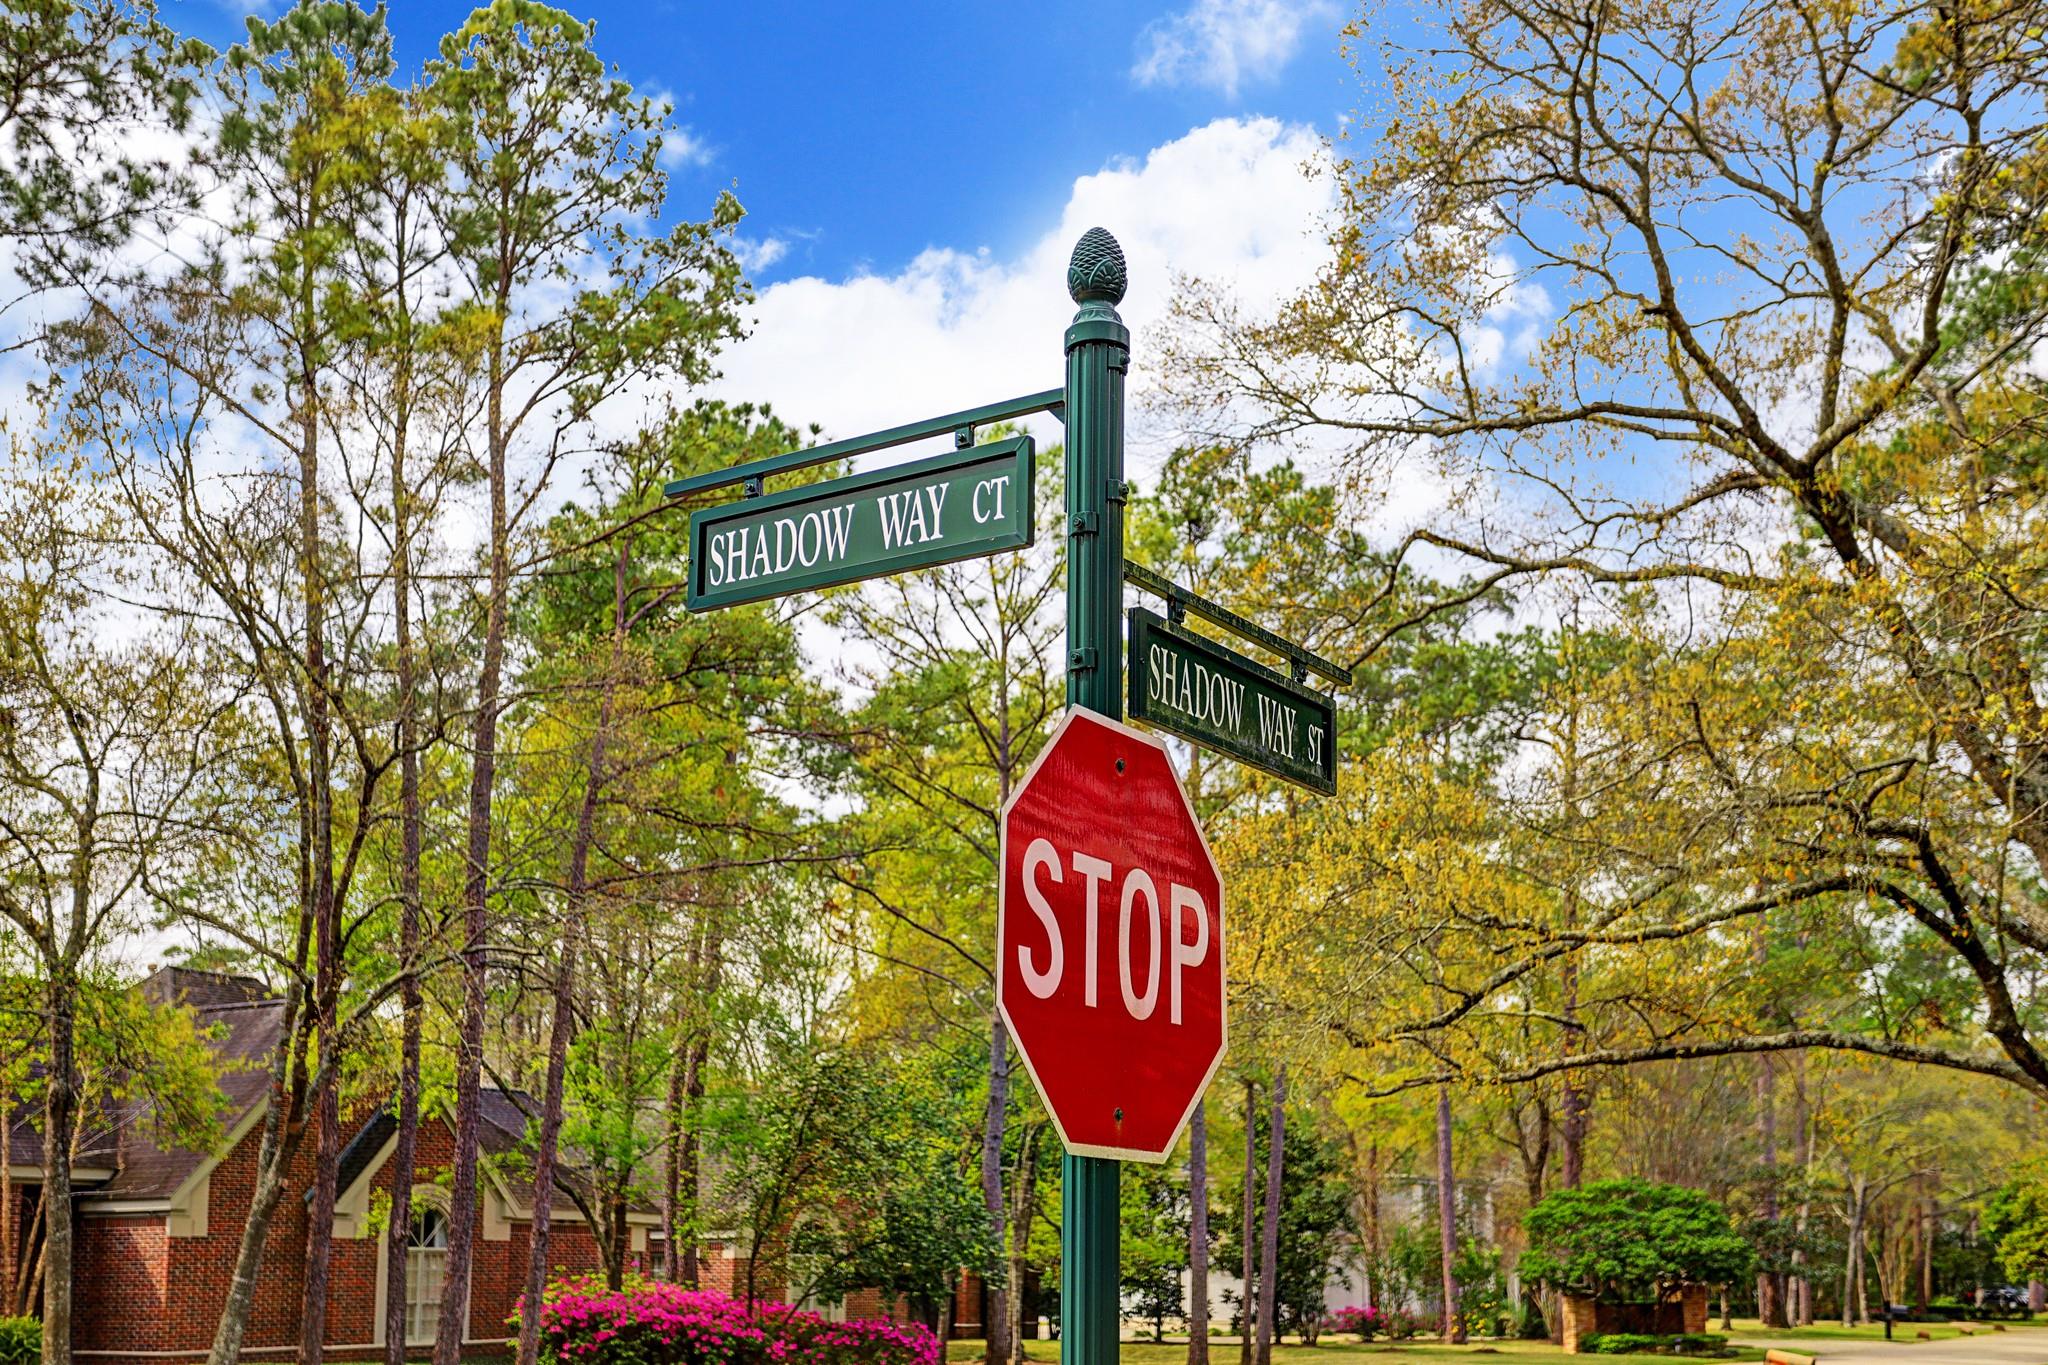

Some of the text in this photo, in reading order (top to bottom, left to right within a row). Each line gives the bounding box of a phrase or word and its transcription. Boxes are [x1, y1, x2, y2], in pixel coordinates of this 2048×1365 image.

[710, 476, 1009, 586] SHADOW WAY CT
[1150, 643, 1325, 766] SHADOW WAY ST
[1017, 837, 1209, 1025] STOP
